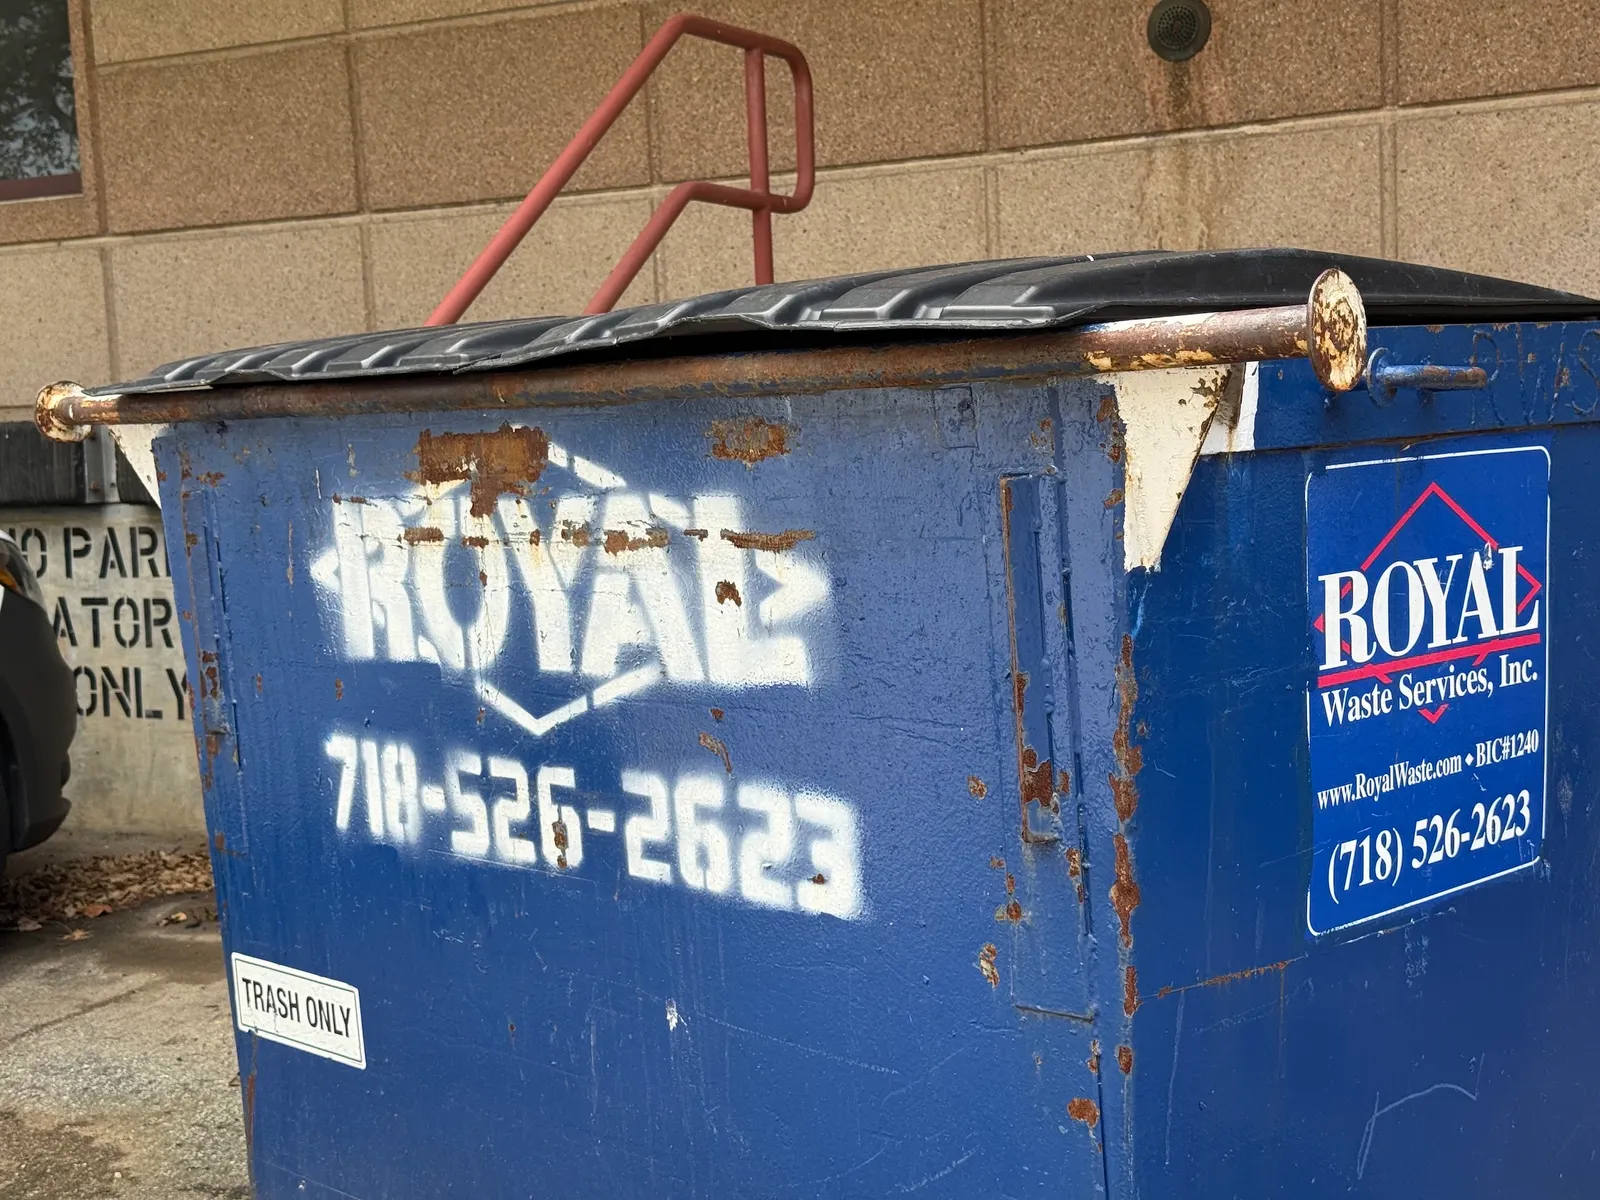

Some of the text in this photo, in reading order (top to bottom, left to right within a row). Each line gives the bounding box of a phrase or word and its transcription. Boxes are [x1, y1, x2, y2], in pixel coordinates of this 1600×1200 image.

[9, 527, 47, 578] O
[332, 492, 812, 688] ROYAL
[1317, 545, 1540, 671] ROYAL
[74, 665, 187, 720] ONLY
[1321, 653, 1538, 727] Waste Services, Inc.
[1317, 728, 1539, 810] www.RoyalWaste.com BIC#1240
[324, 734, 866, 922] 718-526-2623
[1328, 789, 1532, 904] (718) 526-2623
[242, 977, 351, 1038] TRASH ONLY
